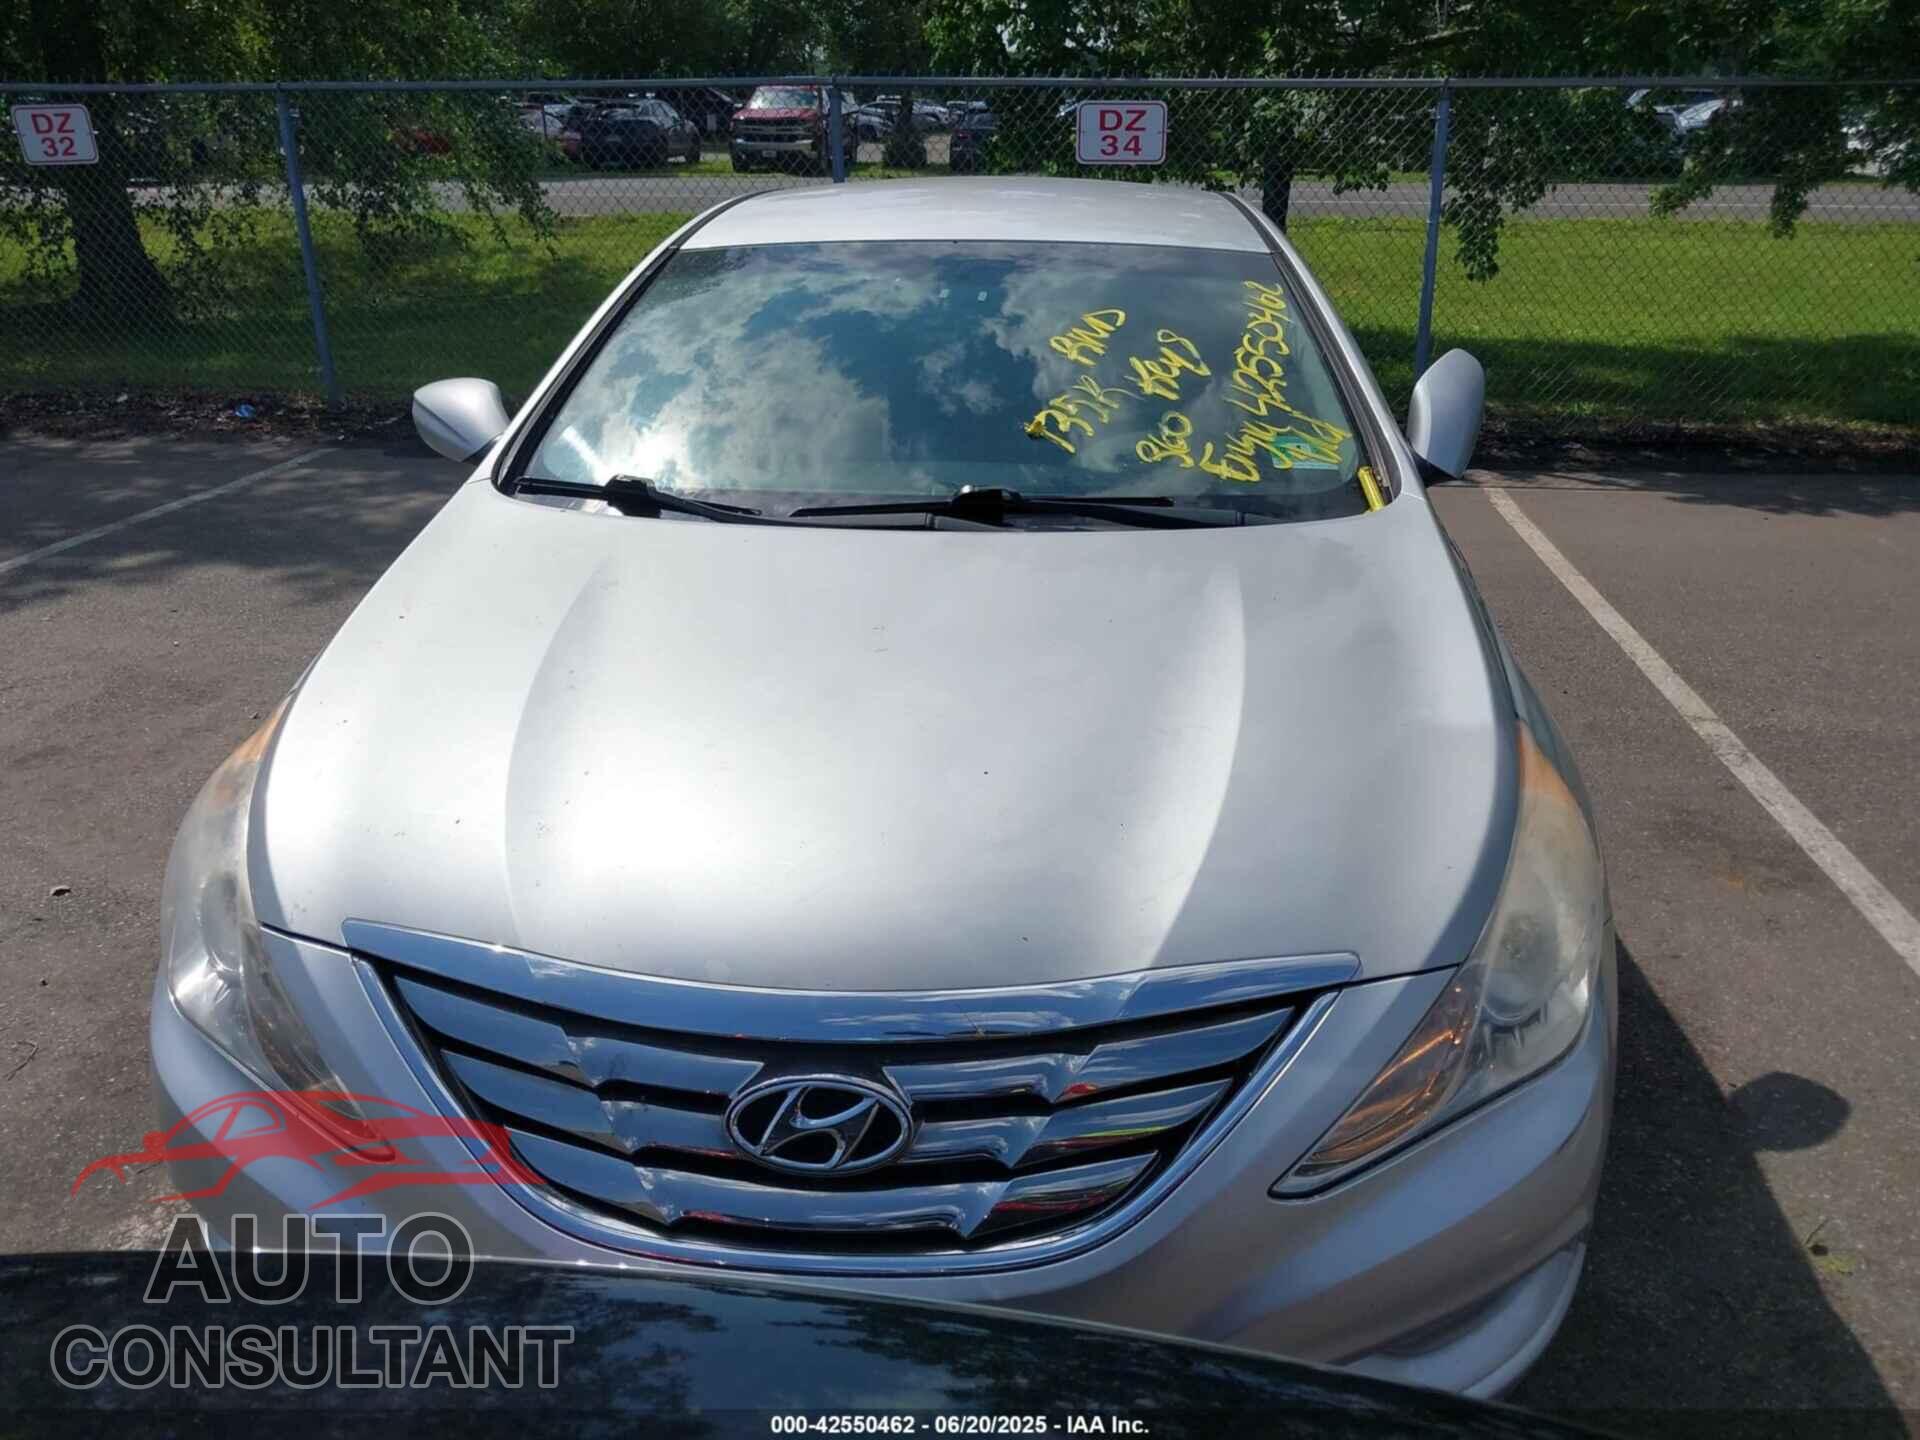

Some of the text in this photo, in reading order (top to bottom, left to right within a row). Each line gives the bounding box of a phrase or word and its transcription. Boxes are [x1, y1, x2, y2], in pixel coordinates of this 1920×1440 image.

[31, 112, 75, 134] DZ
[1099, 109, 1147, 131] DZ
[41, 136, 78, 157] 32
[1100, 134, 1142, 156] 34
